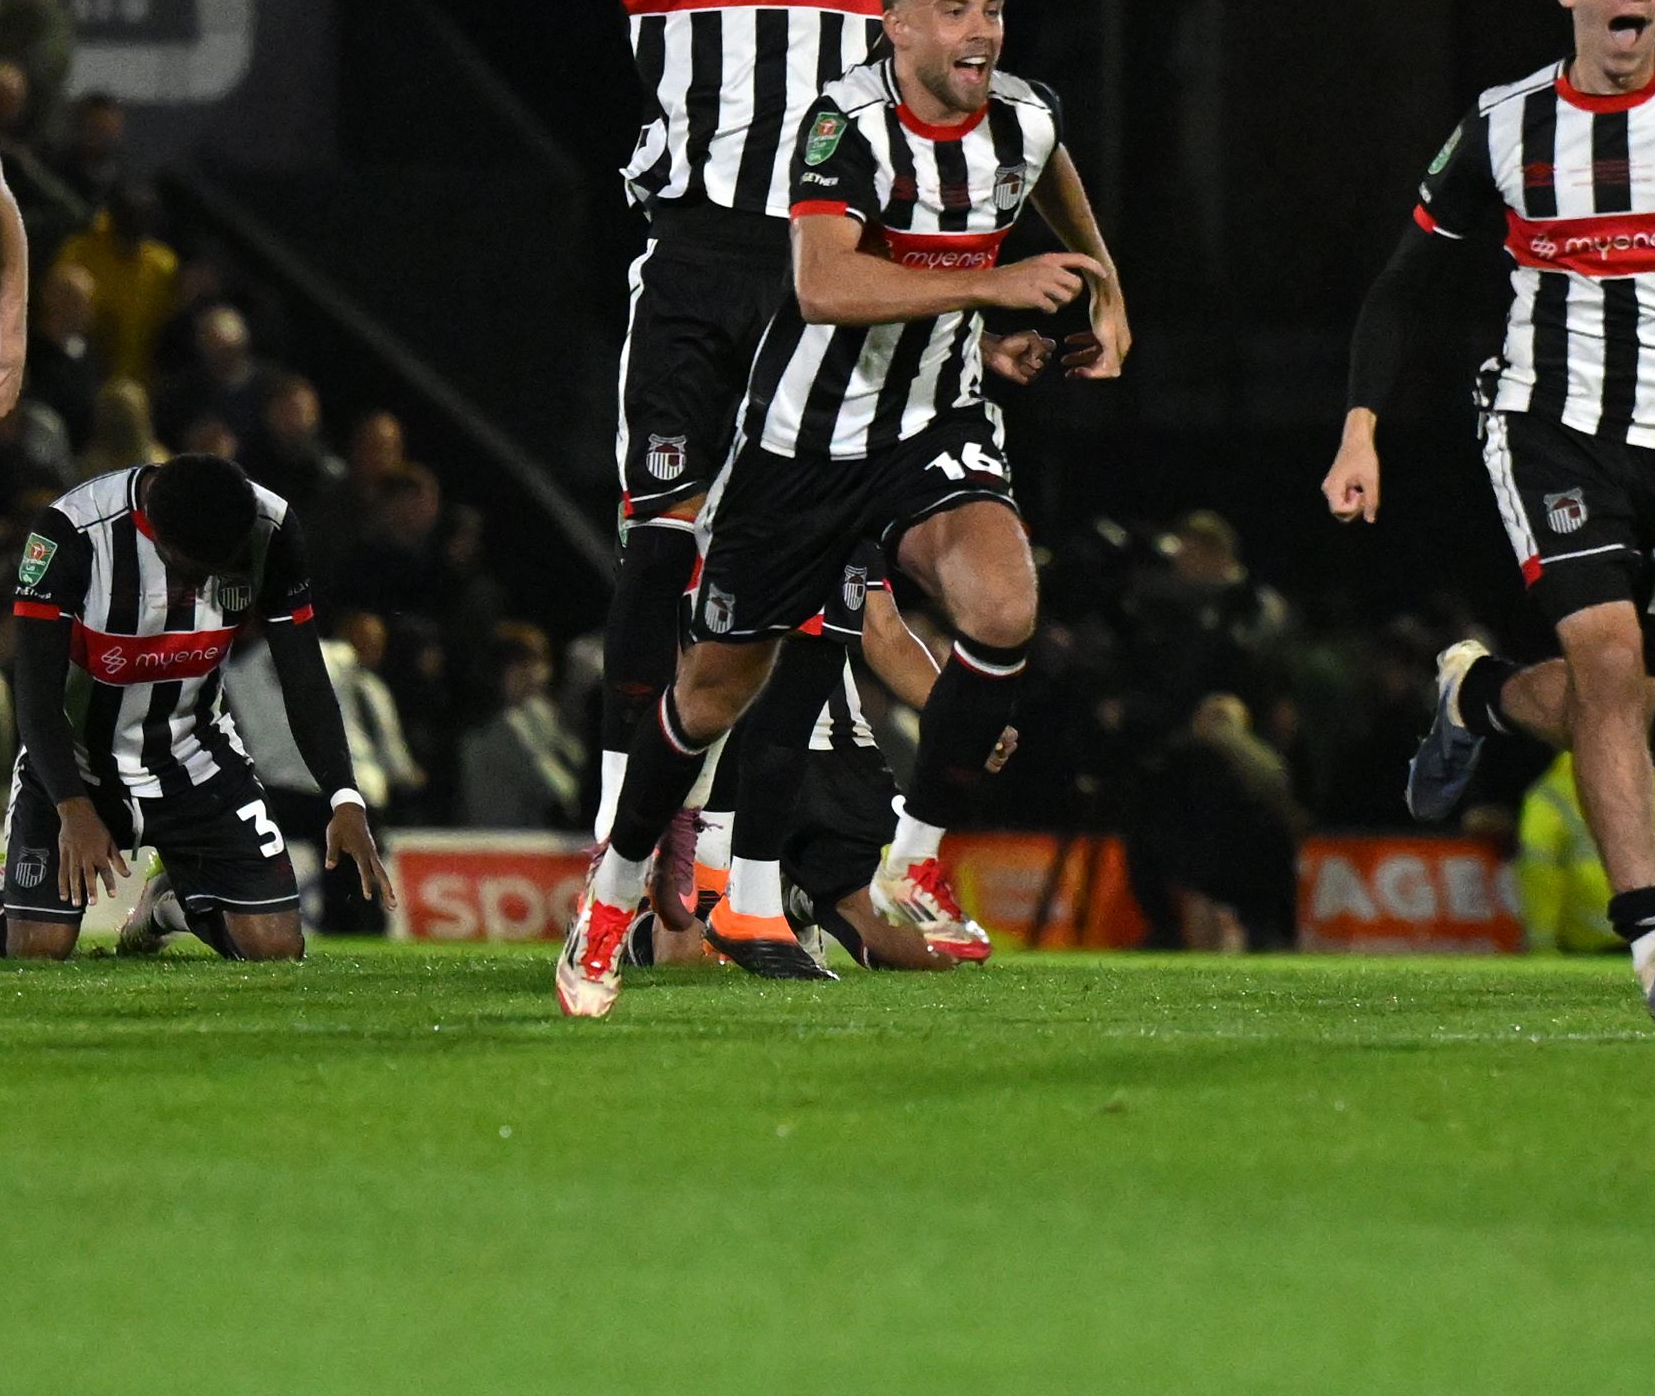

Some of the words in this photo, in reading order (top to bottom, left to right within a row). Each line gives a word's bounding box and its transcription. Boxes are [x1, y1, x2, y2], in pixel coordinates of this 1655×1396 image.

[902, 244, 1000, 270] myene
[924, 443, 1006, 481] 16
[136, 647, 219, 669] myene
[236, 799, 285, 858] 3
